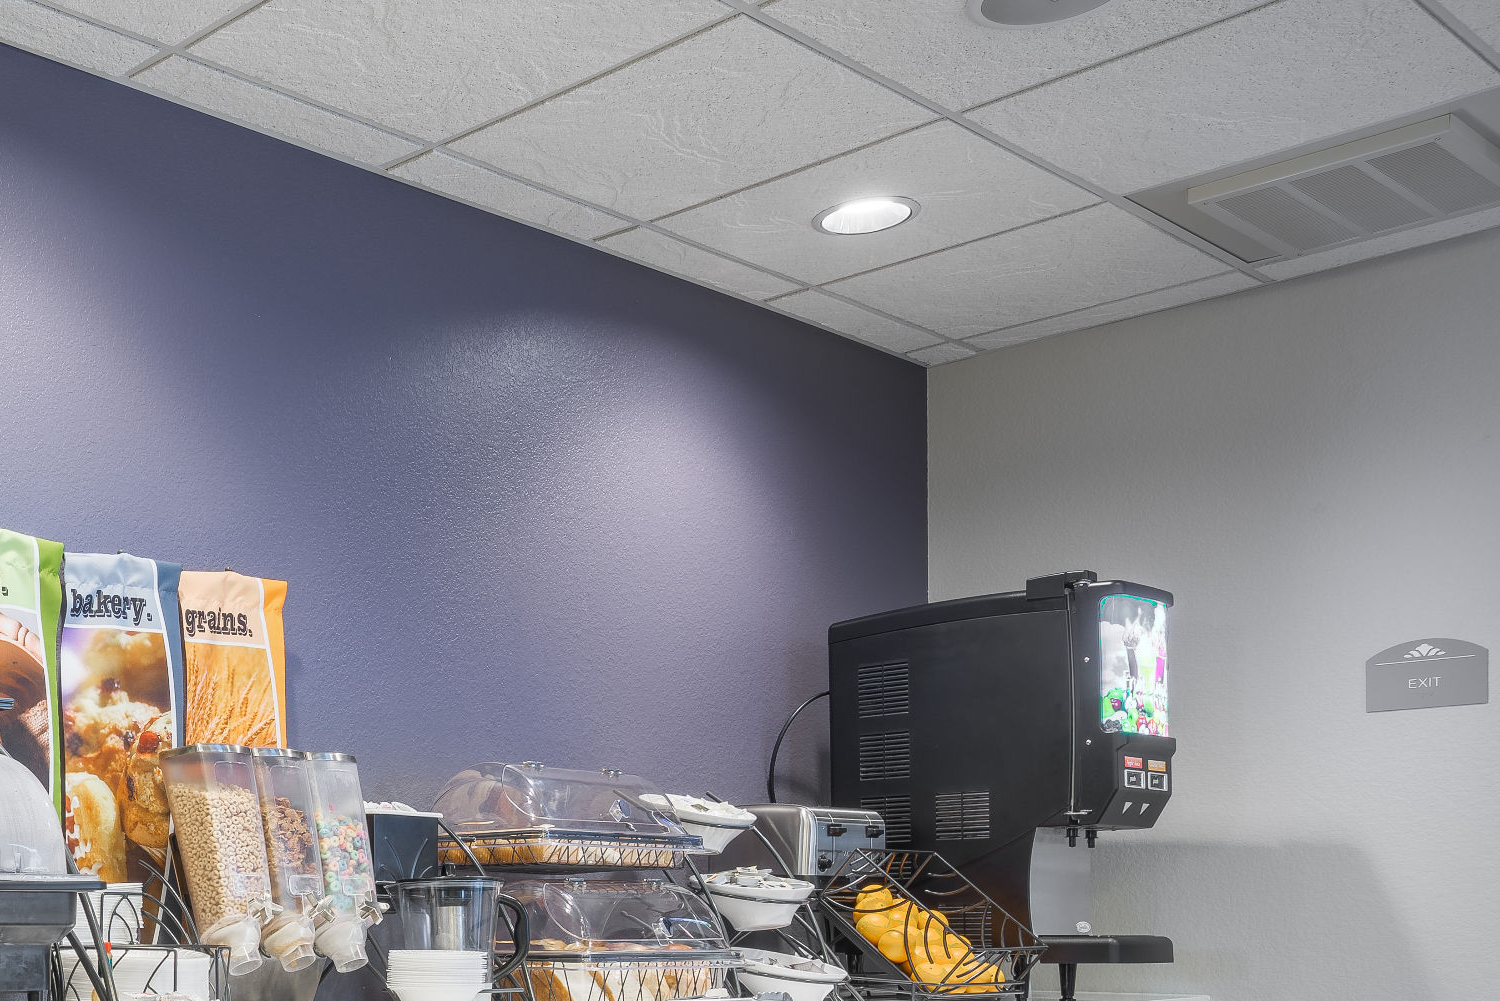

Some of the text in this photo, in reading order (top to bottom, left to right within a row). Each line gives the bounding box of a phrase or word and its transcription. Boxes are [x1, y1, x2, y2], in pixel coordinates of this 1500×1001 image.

[69, 588, 153, 626] bakery.
[184, 606, 254, 638] grains.
[1408, 676, 1441, 689] EXIT
